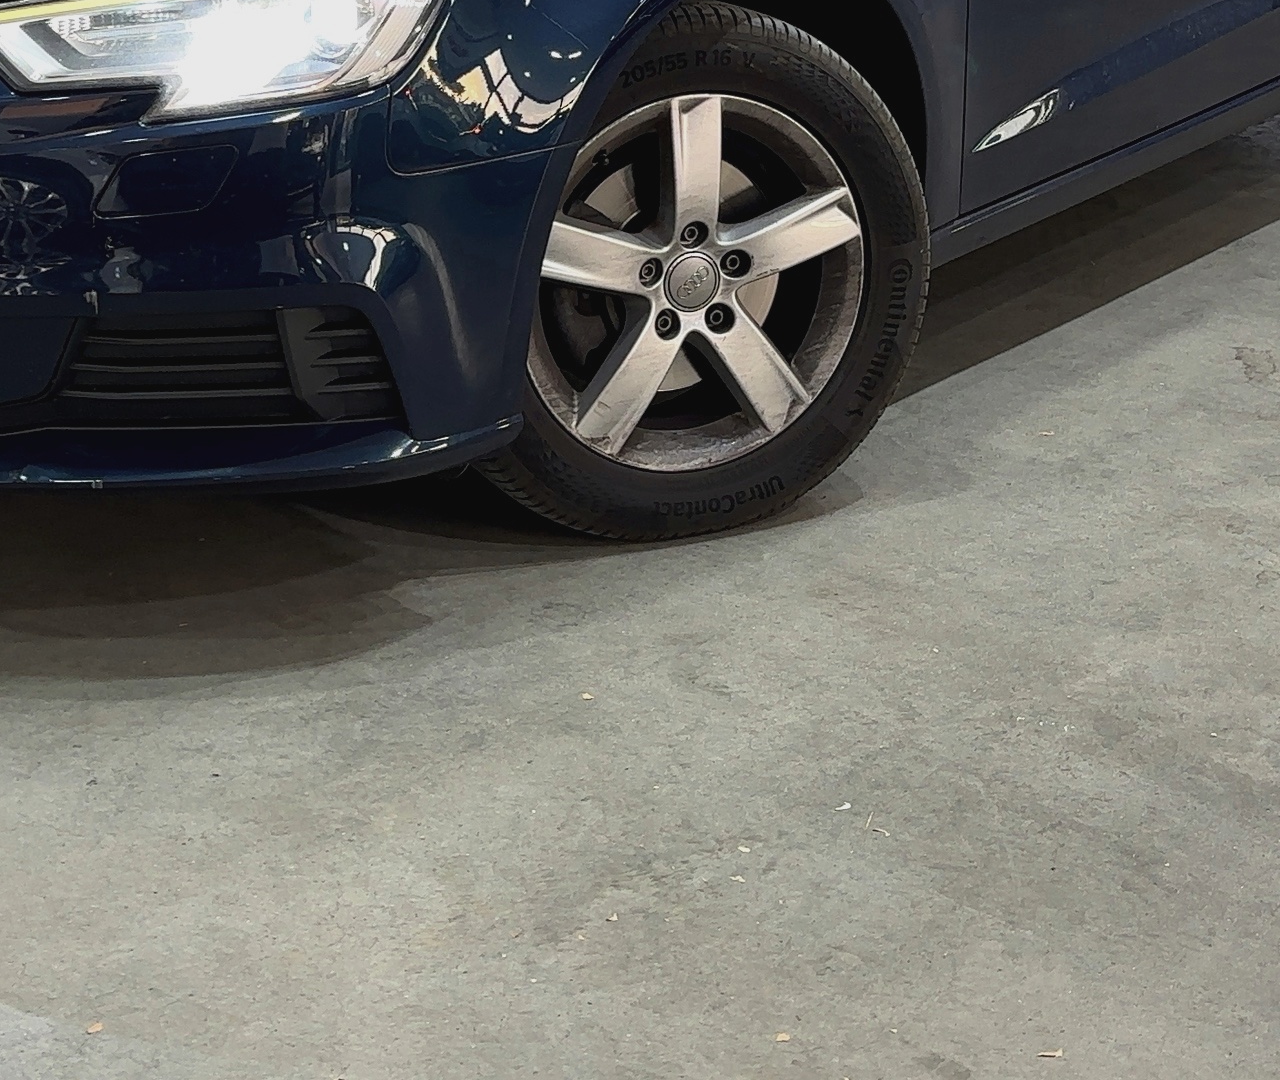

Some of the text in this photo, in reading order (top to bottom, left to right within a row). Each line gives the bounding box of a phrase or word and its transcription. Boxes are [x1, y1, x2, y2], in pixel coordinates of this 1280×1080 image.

[620, 51, 688, 88] 205/55
[695, 50, 708, 67] R
[713, 49, 732, 66] 16
[855, 258, 913, 401] Continental
[654, 475, 786, 519] UltraContact
